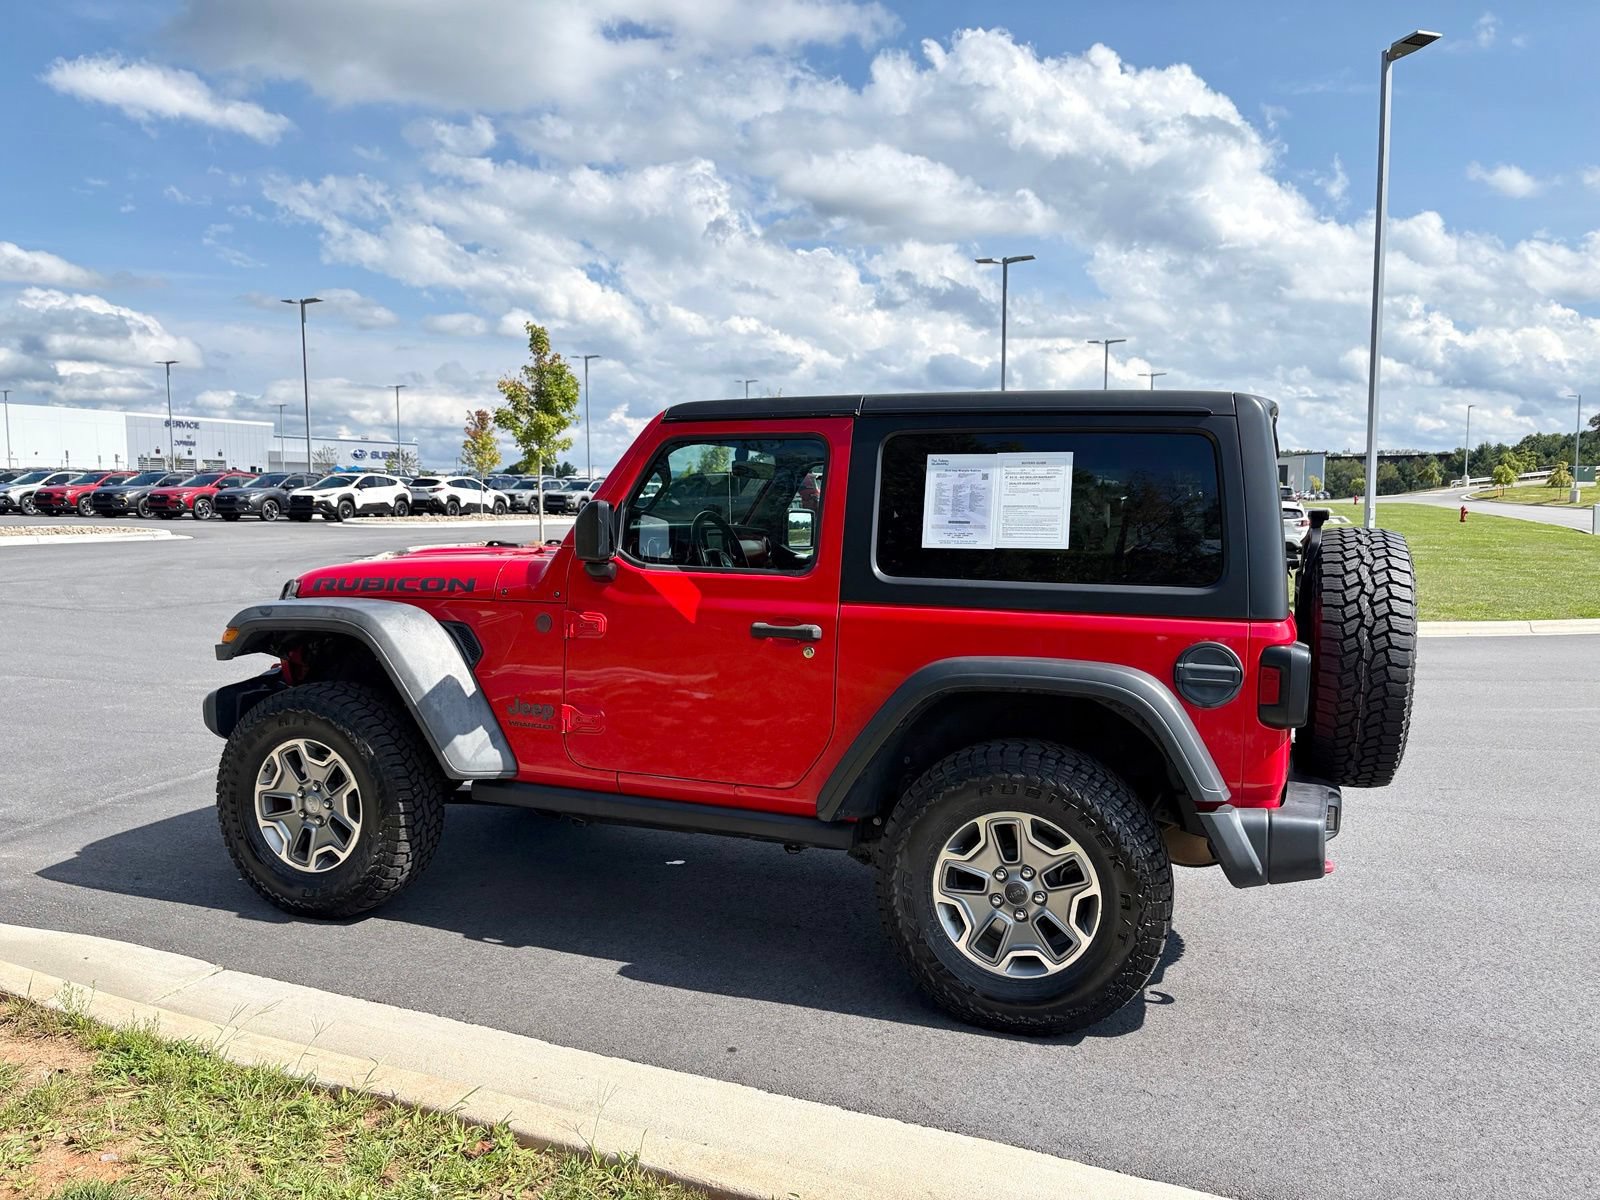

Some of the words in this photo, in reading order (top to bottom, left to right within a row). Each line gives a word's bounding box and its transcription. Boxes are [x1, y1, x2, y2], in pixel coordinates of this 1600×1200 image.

[164, 419, 200, 430] SERVICE
[312, 577, 477, 593] RUBICON
[507, 696, 555, 721] Jeep
